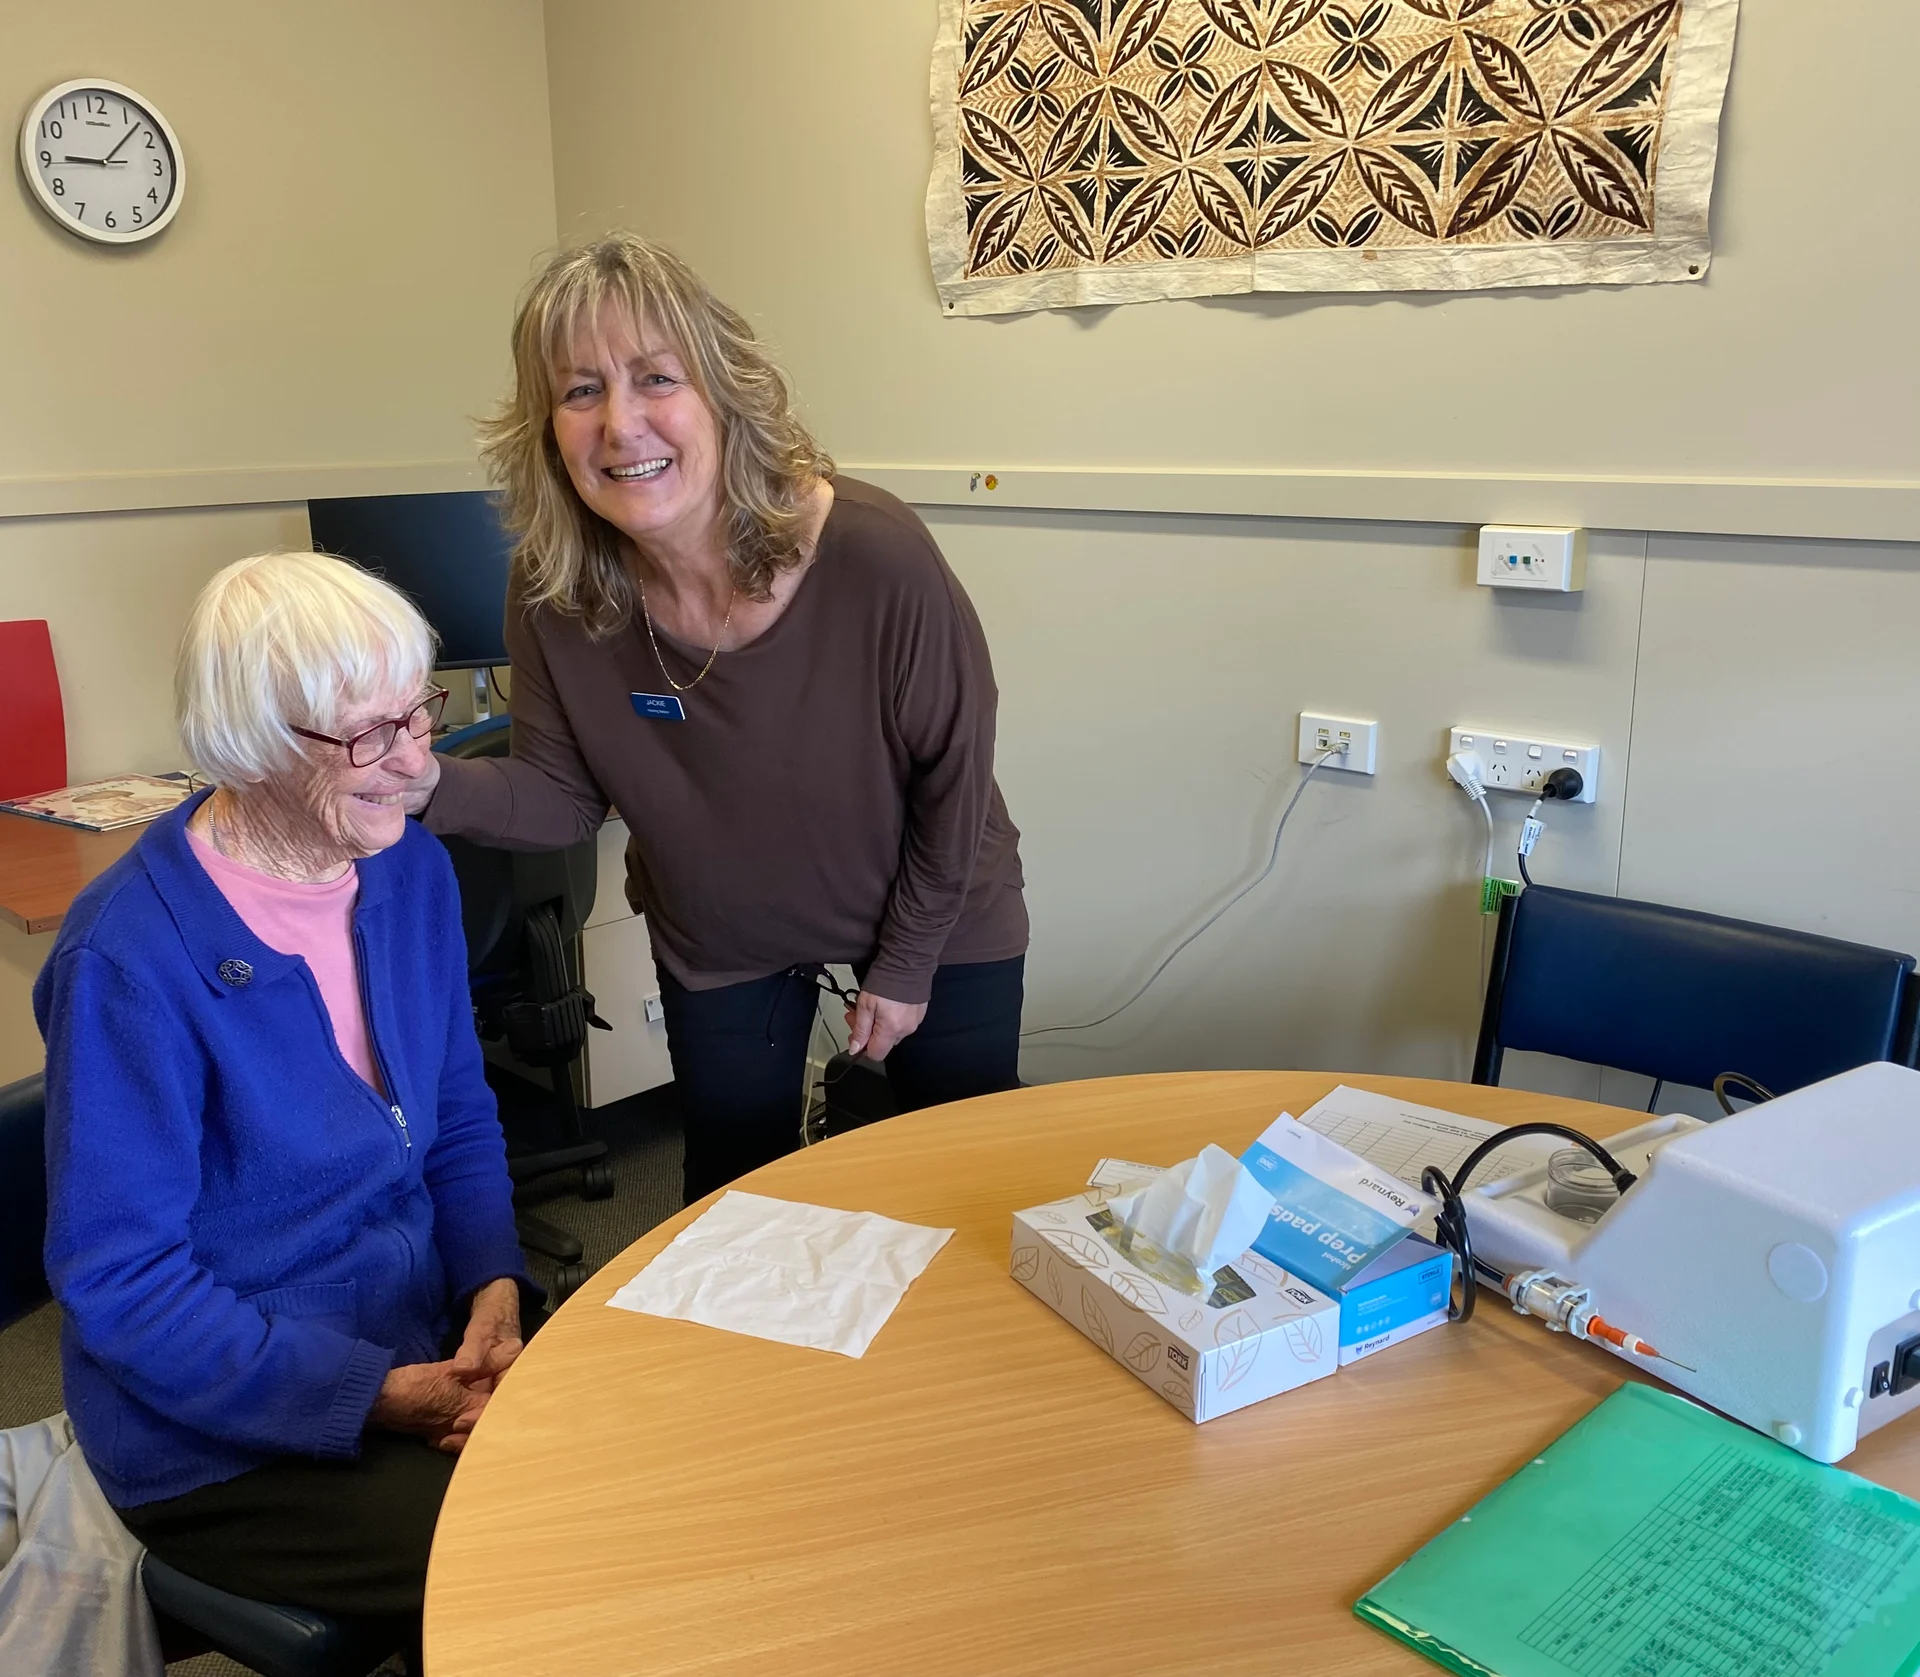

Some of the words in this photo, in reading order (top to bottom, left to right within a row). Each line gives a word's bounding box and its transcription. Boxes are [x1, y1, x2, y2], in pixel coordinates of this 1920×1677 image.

[60, 101, 77, 120] 11
[86, 95, 107, 115] 12
[123, 107, 128, 124] 1
[41, 120, 63, 139] 10
[143, 131, 155, 149] 2
[40, 151, 51, 168] 9
[152, 158, 163, 177] 3
[52, 178, 65, 196] 8
[147, 187, 158, 204] 4
[74, 202, 86, 220] 7
[105, 210, 116, 228] 6
[132, 205, 143, 224] 5
[646, 699, 666, 707] JACKIE
[1358, 1177, 1406, 1208] Reynard
[1270, 1204, 1321, 1236] pads
[1318, 1231, 1367, 1265] Prep
[1321, 1251, 1354, 1271] Alcohol
[1421, 1268, 1440, 1280] STERILE
[1287, 1288, 1309, 1304] TORK
[1364, 1334, 1390, 1350] Reynard
[1168, 1347, 1188, 1369] TORK
